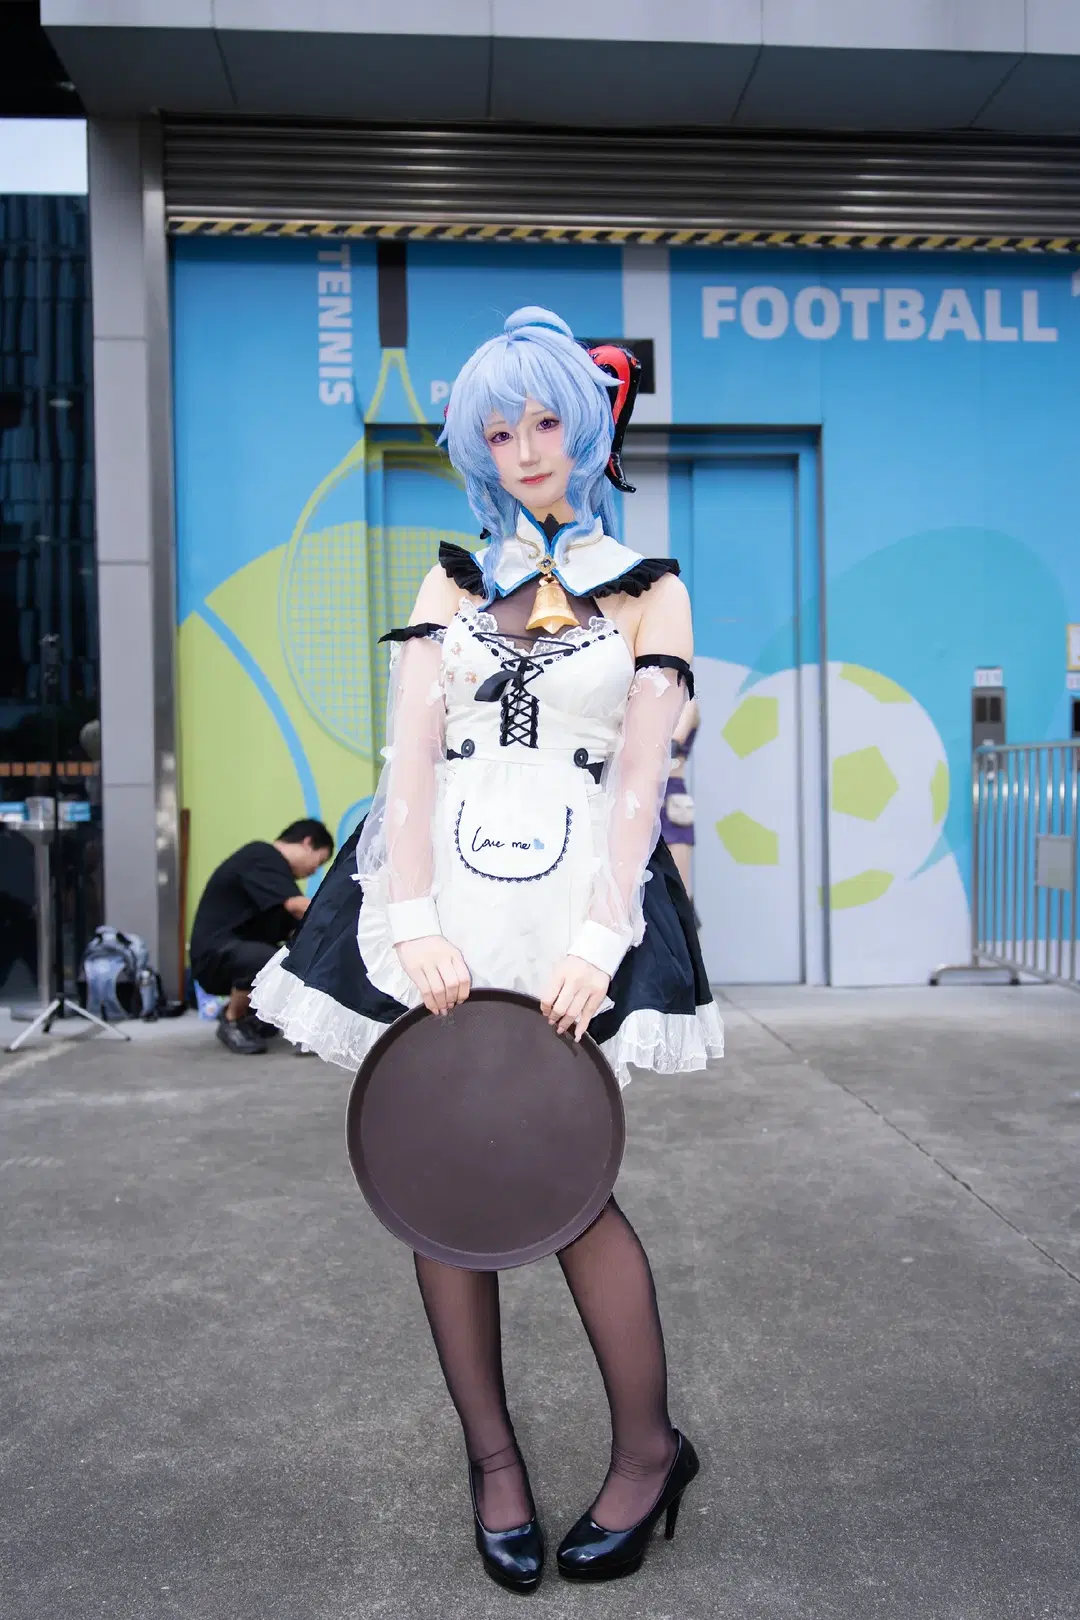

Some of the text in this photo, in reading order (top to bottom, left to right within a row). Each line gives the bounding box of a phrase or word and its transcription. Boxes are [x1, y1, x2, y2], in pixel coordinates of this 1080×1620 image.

[317, 243, 354, 405] TENNIS
[701, 285, 1058, 342] FOOTBALL
[511, 841, 531, 850] me
